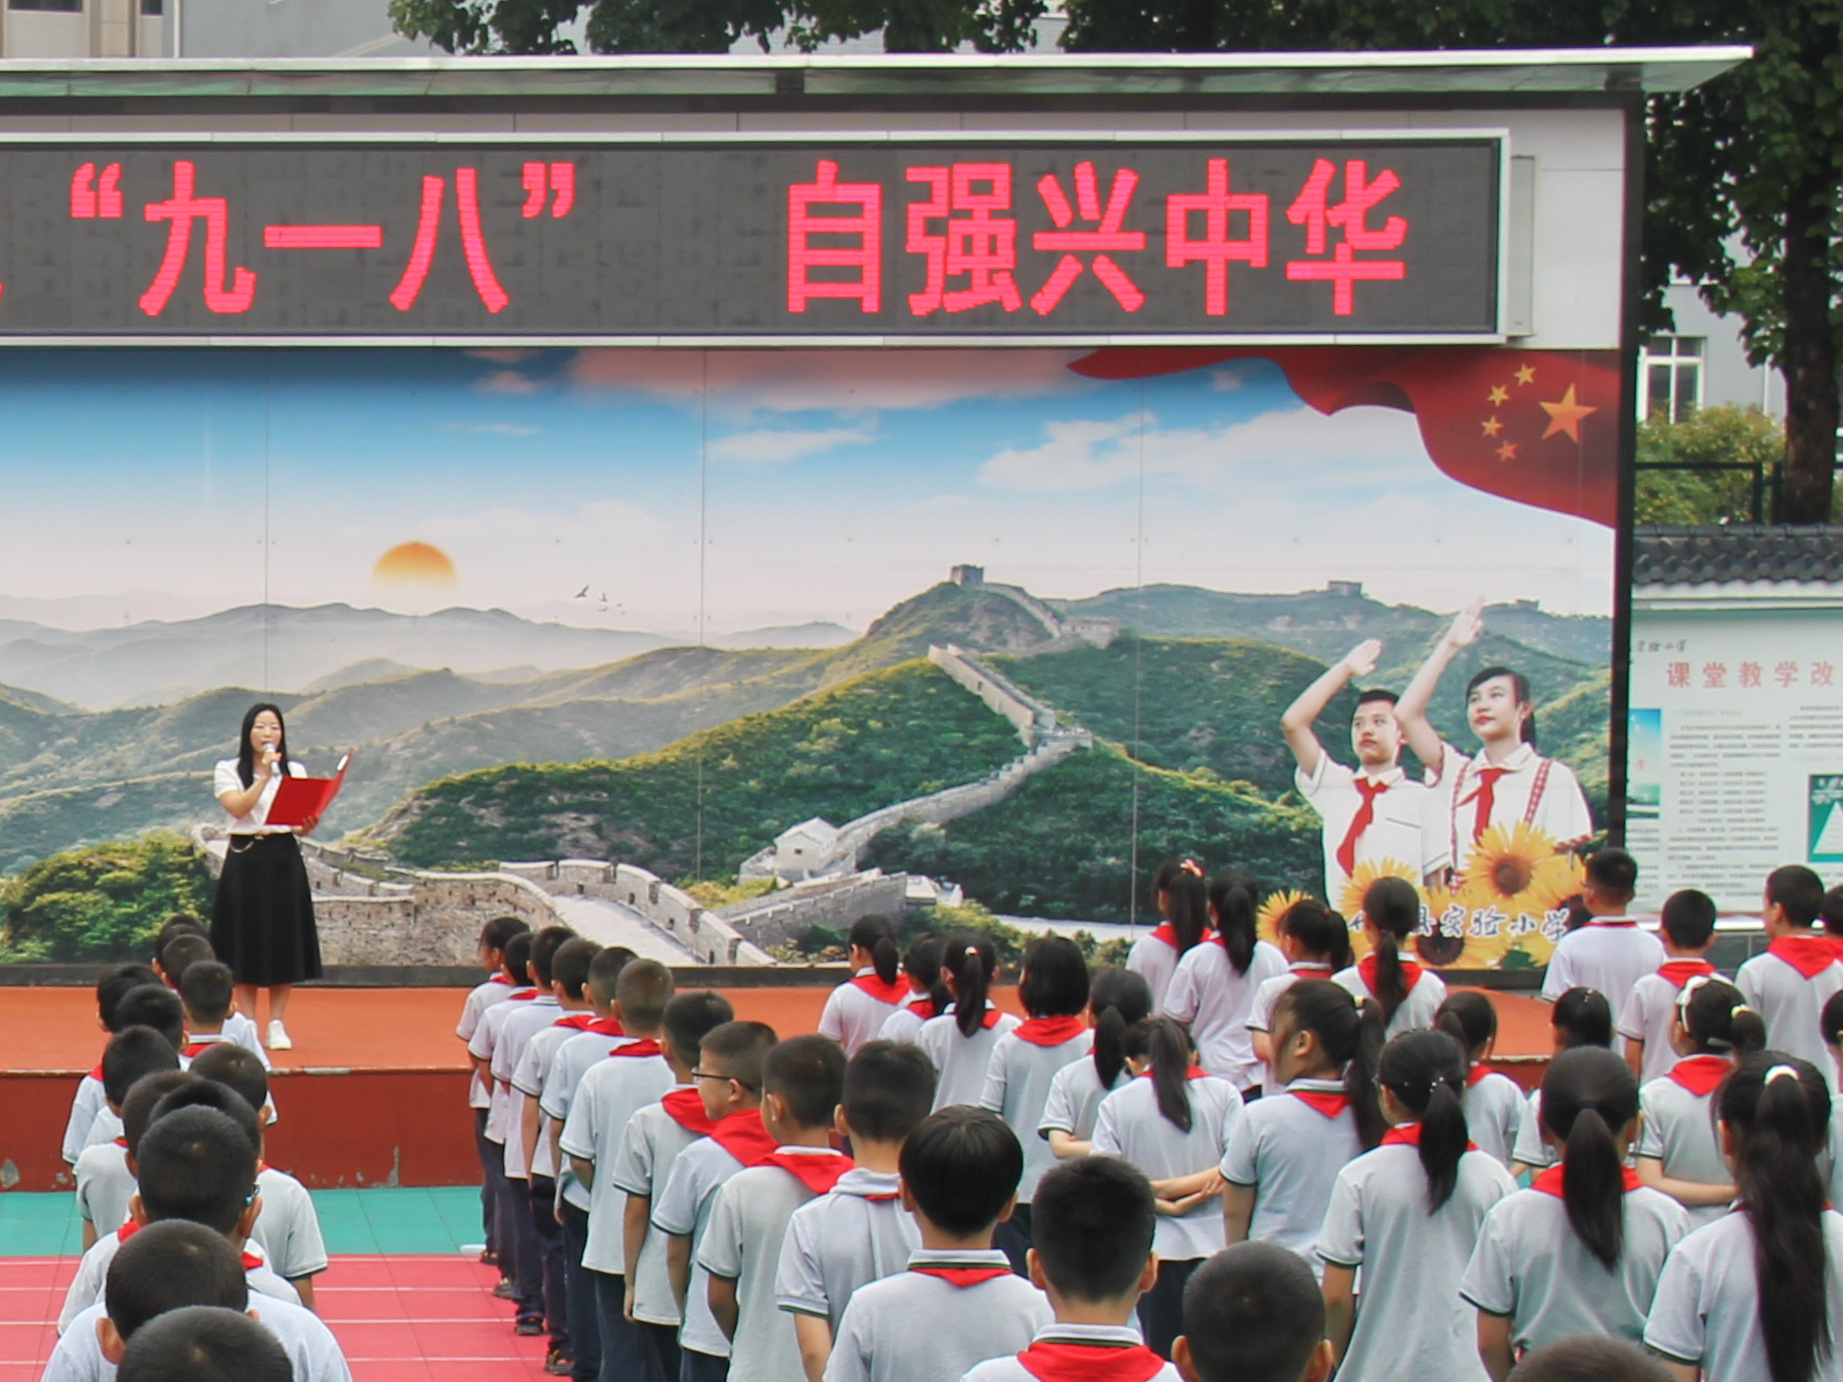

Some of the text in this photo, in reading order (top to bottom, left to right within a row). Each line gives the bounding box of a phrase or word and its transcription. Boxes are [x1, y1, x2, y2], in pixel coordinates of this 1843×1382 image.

[788, 159, 1407, 316] 自强兴中华
[1667, 661, 1834, 689] 课堂教学改
[1349, 904, 1571, 943] 县实验小学
